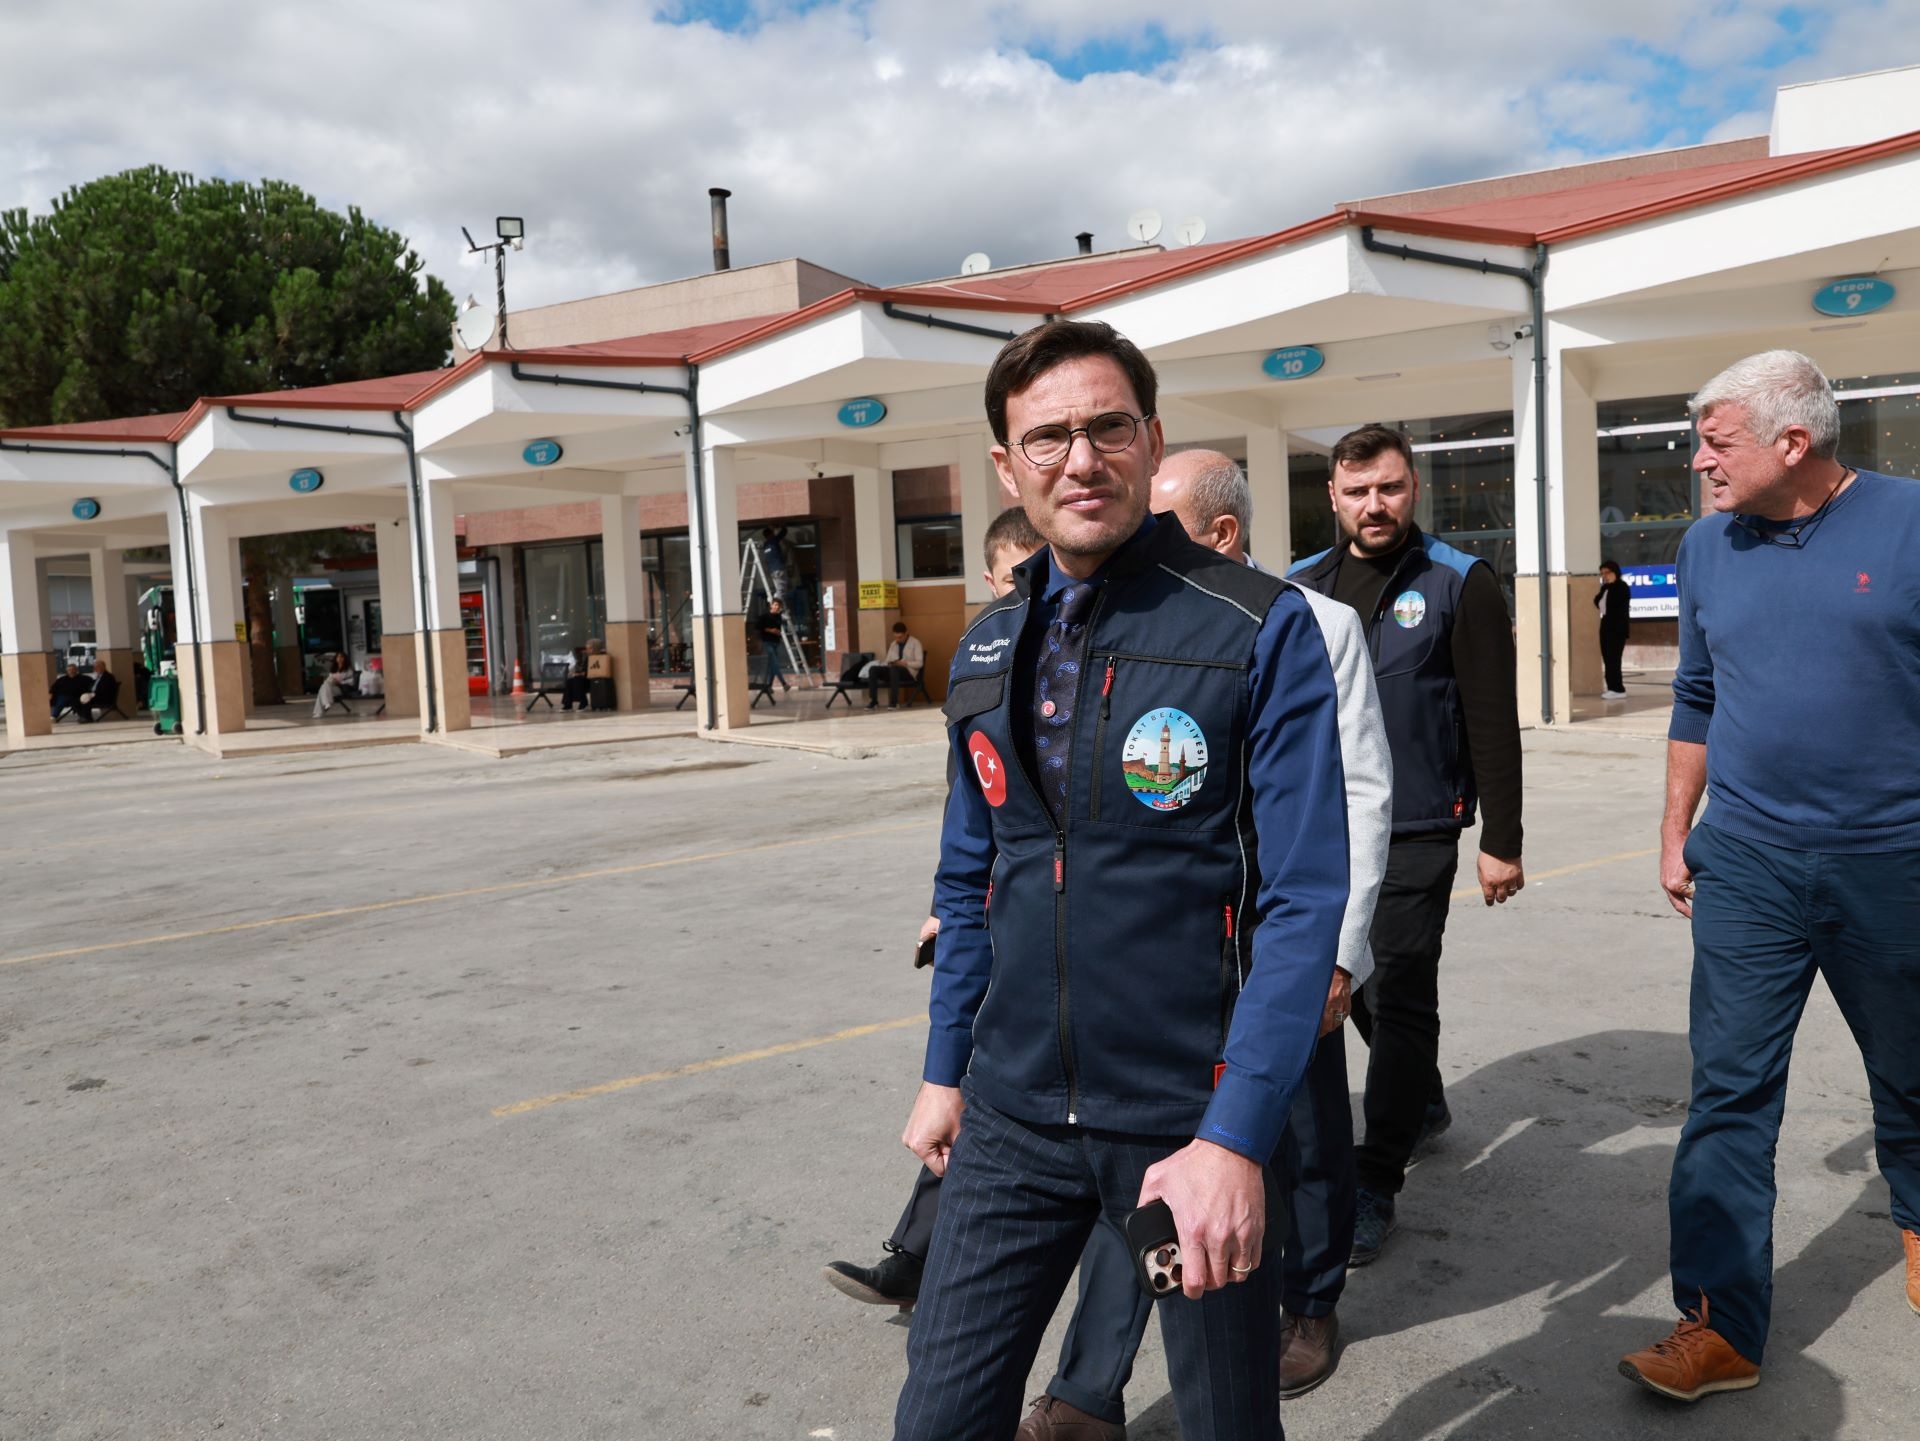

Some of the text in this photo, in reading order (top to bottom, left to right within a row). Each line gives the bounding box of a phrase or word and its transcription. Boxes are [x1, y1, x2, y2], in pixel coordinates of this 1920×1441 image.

[1833, 282, 1874, 293] PERON
[1846, 293, 1862, 309] 9
[1276, 350, 1307, 360] PERON
[1283, 359, 1303, 374] 10
[854, 411, 866, 423] 11
[1127, 722, 1147, 757] TOKAT
